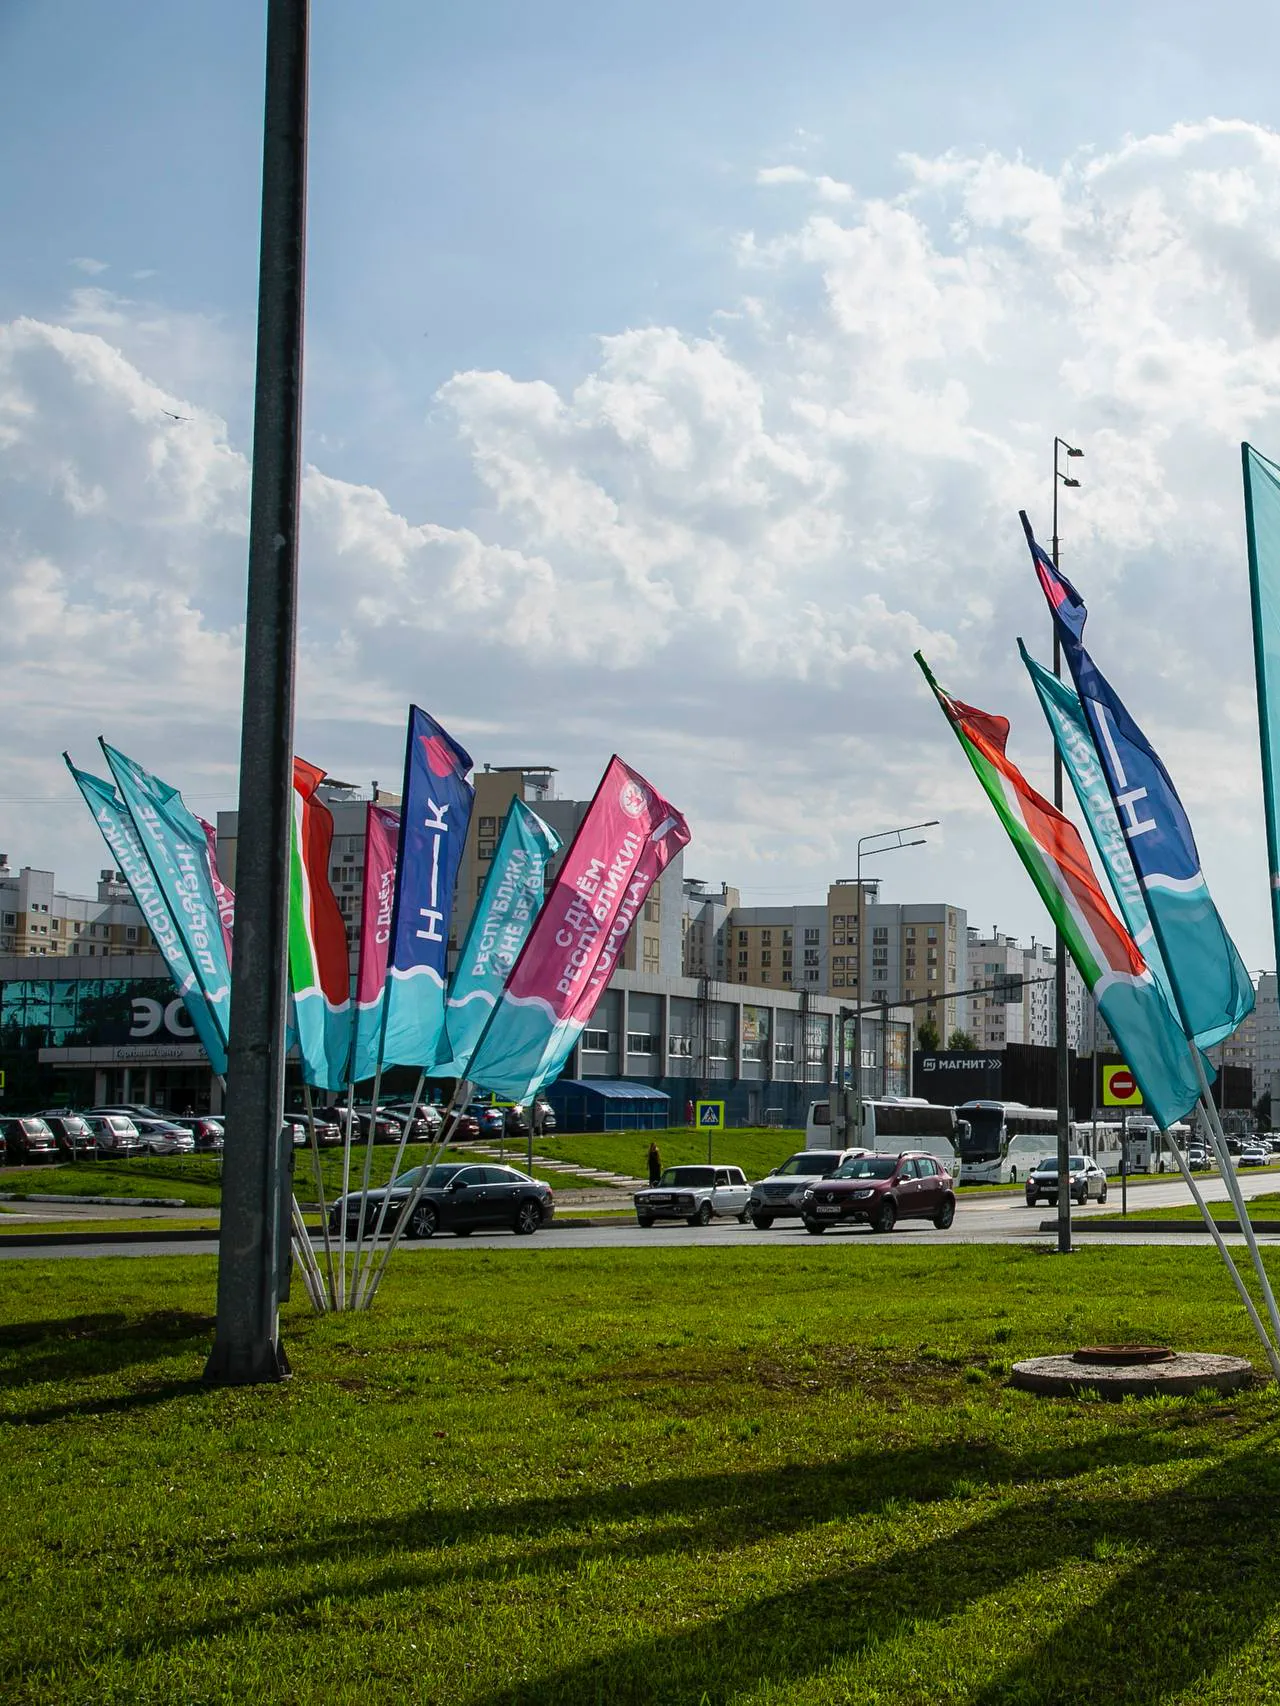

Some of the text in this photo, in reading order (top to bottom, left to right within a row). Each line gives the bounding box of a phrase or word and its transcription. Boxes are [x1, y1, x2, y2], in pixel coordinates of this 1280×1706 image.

[556, 831, 642, 996] РЕСПУБЛИКИ!
[564, 858, 607, 930] ДНЁМ
[938, 1060, 986, 1069] МАГНИТ
